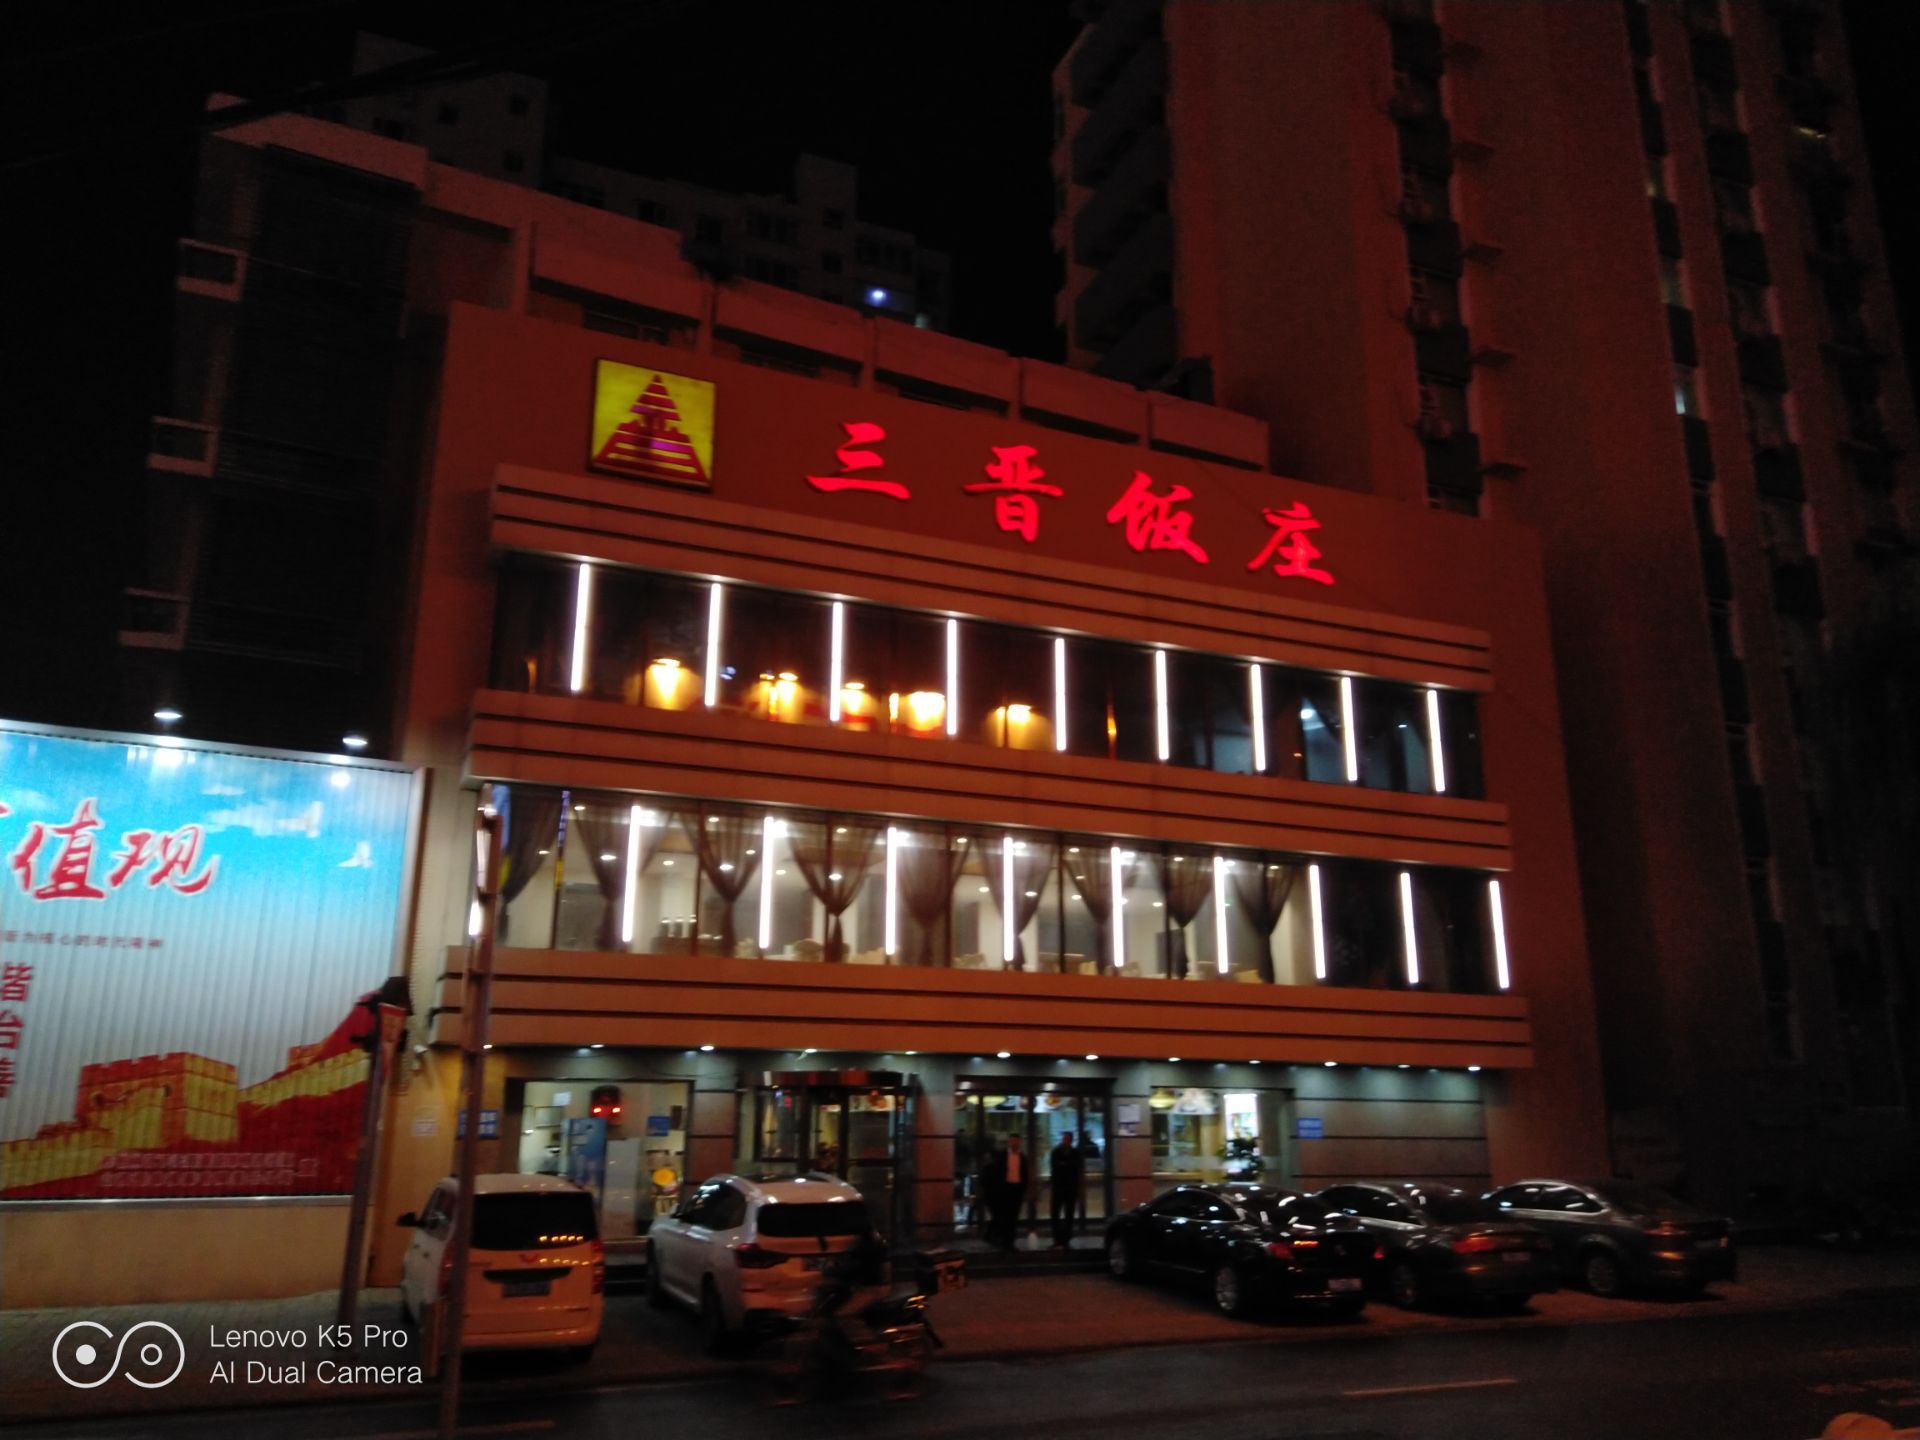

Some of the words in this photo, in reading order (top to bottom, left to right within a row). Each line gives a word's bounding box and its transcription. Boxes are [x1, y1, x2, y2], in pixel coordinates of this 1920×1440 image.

[806, 422, 1334, 585] 三晋饭庄
[0, 799, 218, 899] 值观
